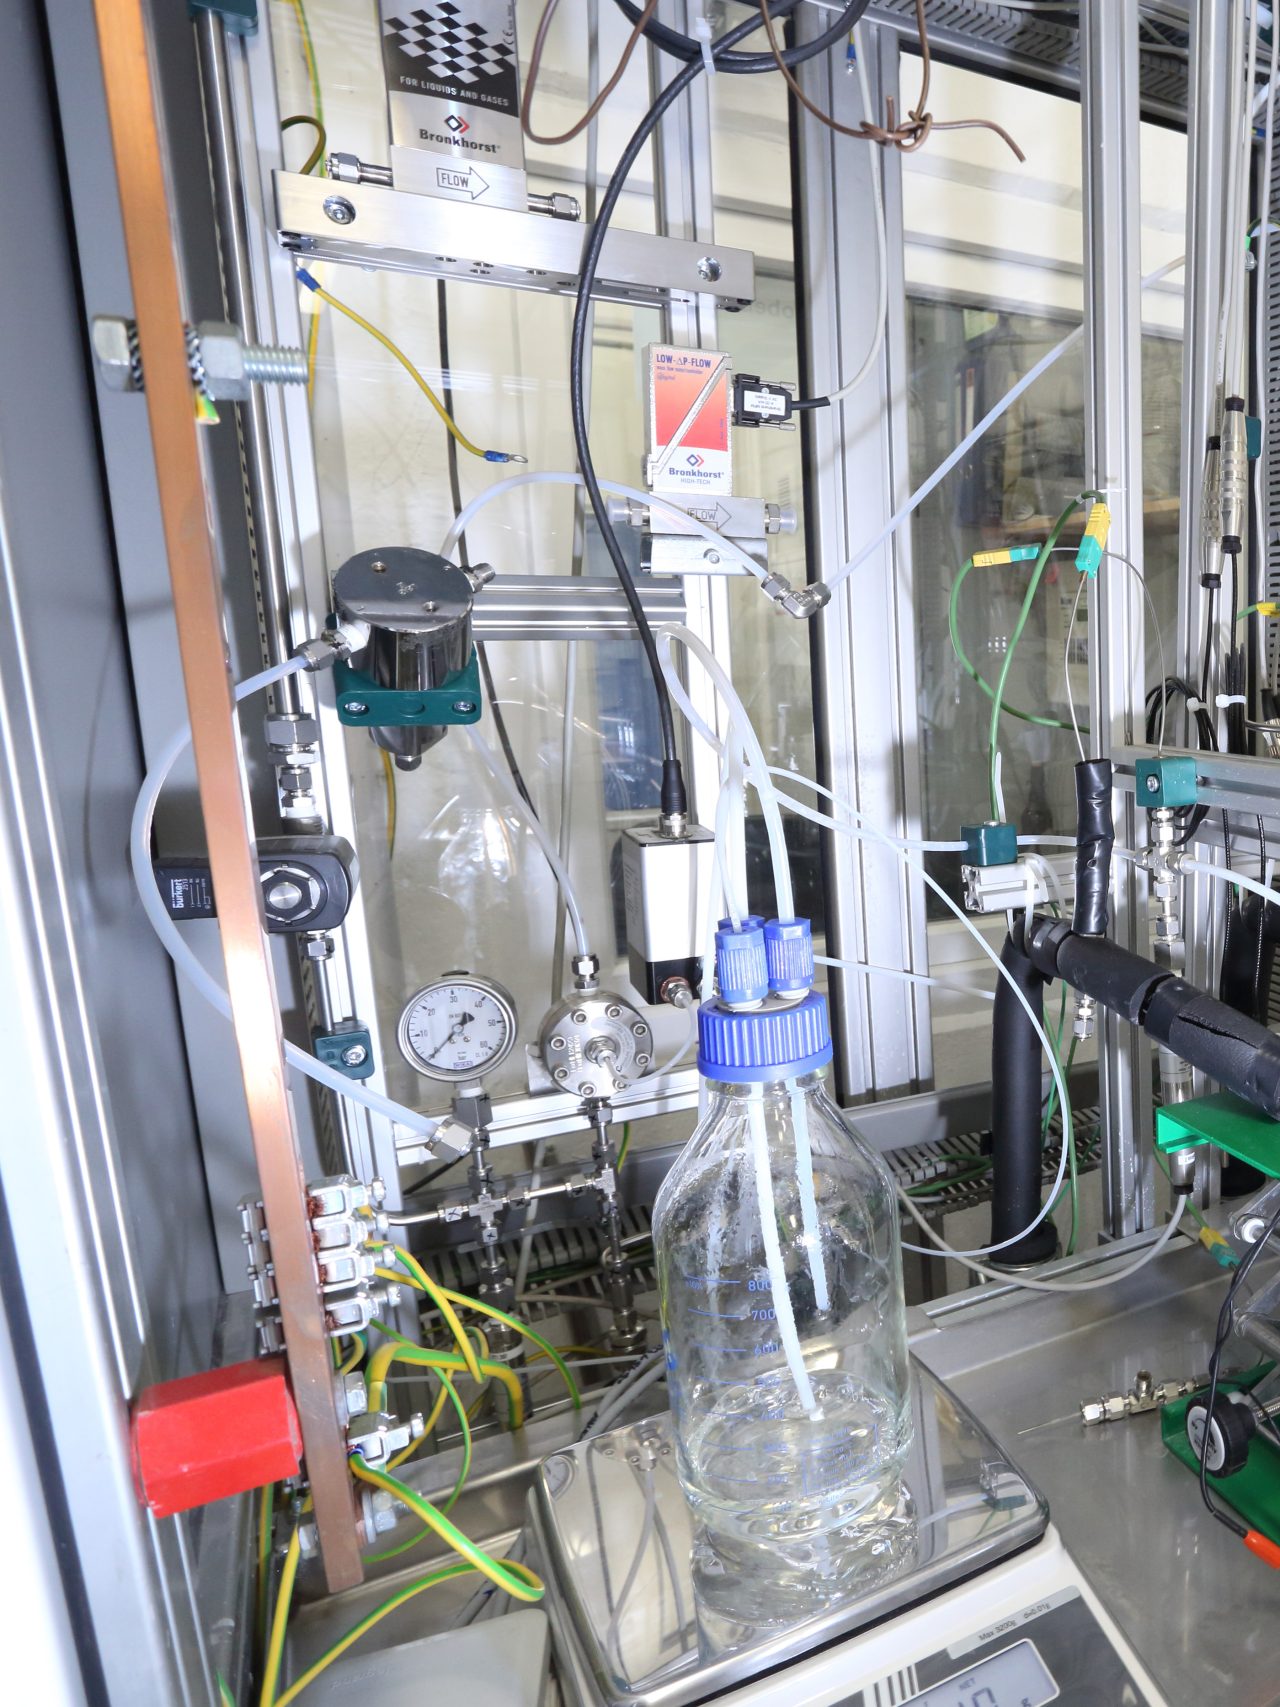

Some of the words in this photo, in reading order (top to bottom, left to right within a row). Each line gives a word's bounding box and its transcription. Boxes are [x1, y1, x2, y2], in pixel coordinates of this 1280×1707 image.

[400, 76, 418, 87] FOR
[421, 80, 457, 96] LIQUIDS
[460, 87, 478, 100] AND
[480, 93, 509, 107] GASES
[418, 128, 498, 154] Bronkhorst
[441, 172, 469, 188] FLOW
[669, 467, 722, 479] Bronkhorst
[449, 996, 458, 1004] 30
[427, 1008, 436, 1017] 20
[978, 1630, 994, 1642] Max
[994, 1618, 1017, 1634] 3200g
[958, 1677, 976, 1691] NET
